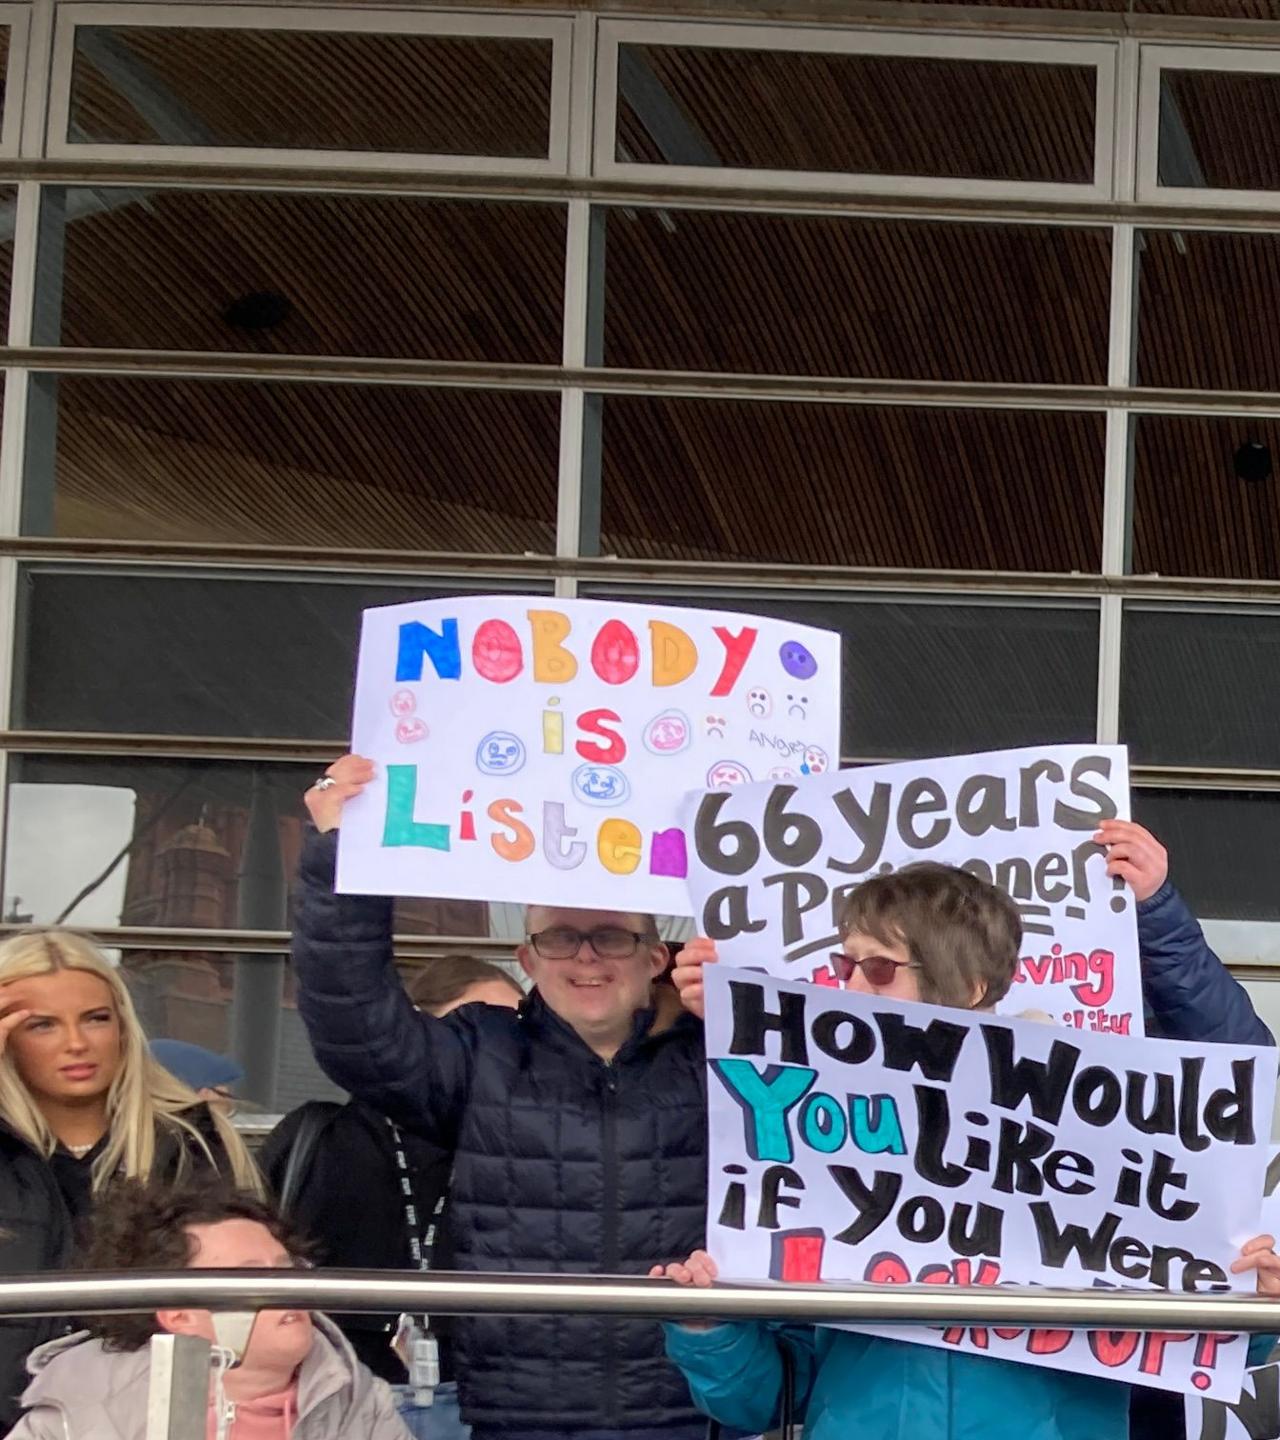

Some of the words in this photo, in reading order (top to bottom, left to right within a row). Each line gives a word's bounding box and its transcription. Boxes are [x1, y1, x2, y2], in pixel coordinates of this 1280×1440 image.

[395, 609, 758, 696] NOBODY
[543, 696, 627, 764] is
[694, 785, 823, 875] 66
[827, 755, 1117, 873] years
[703, 885, 767, 940] a
[728, 980, 970, 1082] How
[980, 1022, 1257, 1151] Would
[706, 1057, 907, 1163] You
[1114, 1148, 1200, 1221] it
[718, 1164, 806, 1230] if
